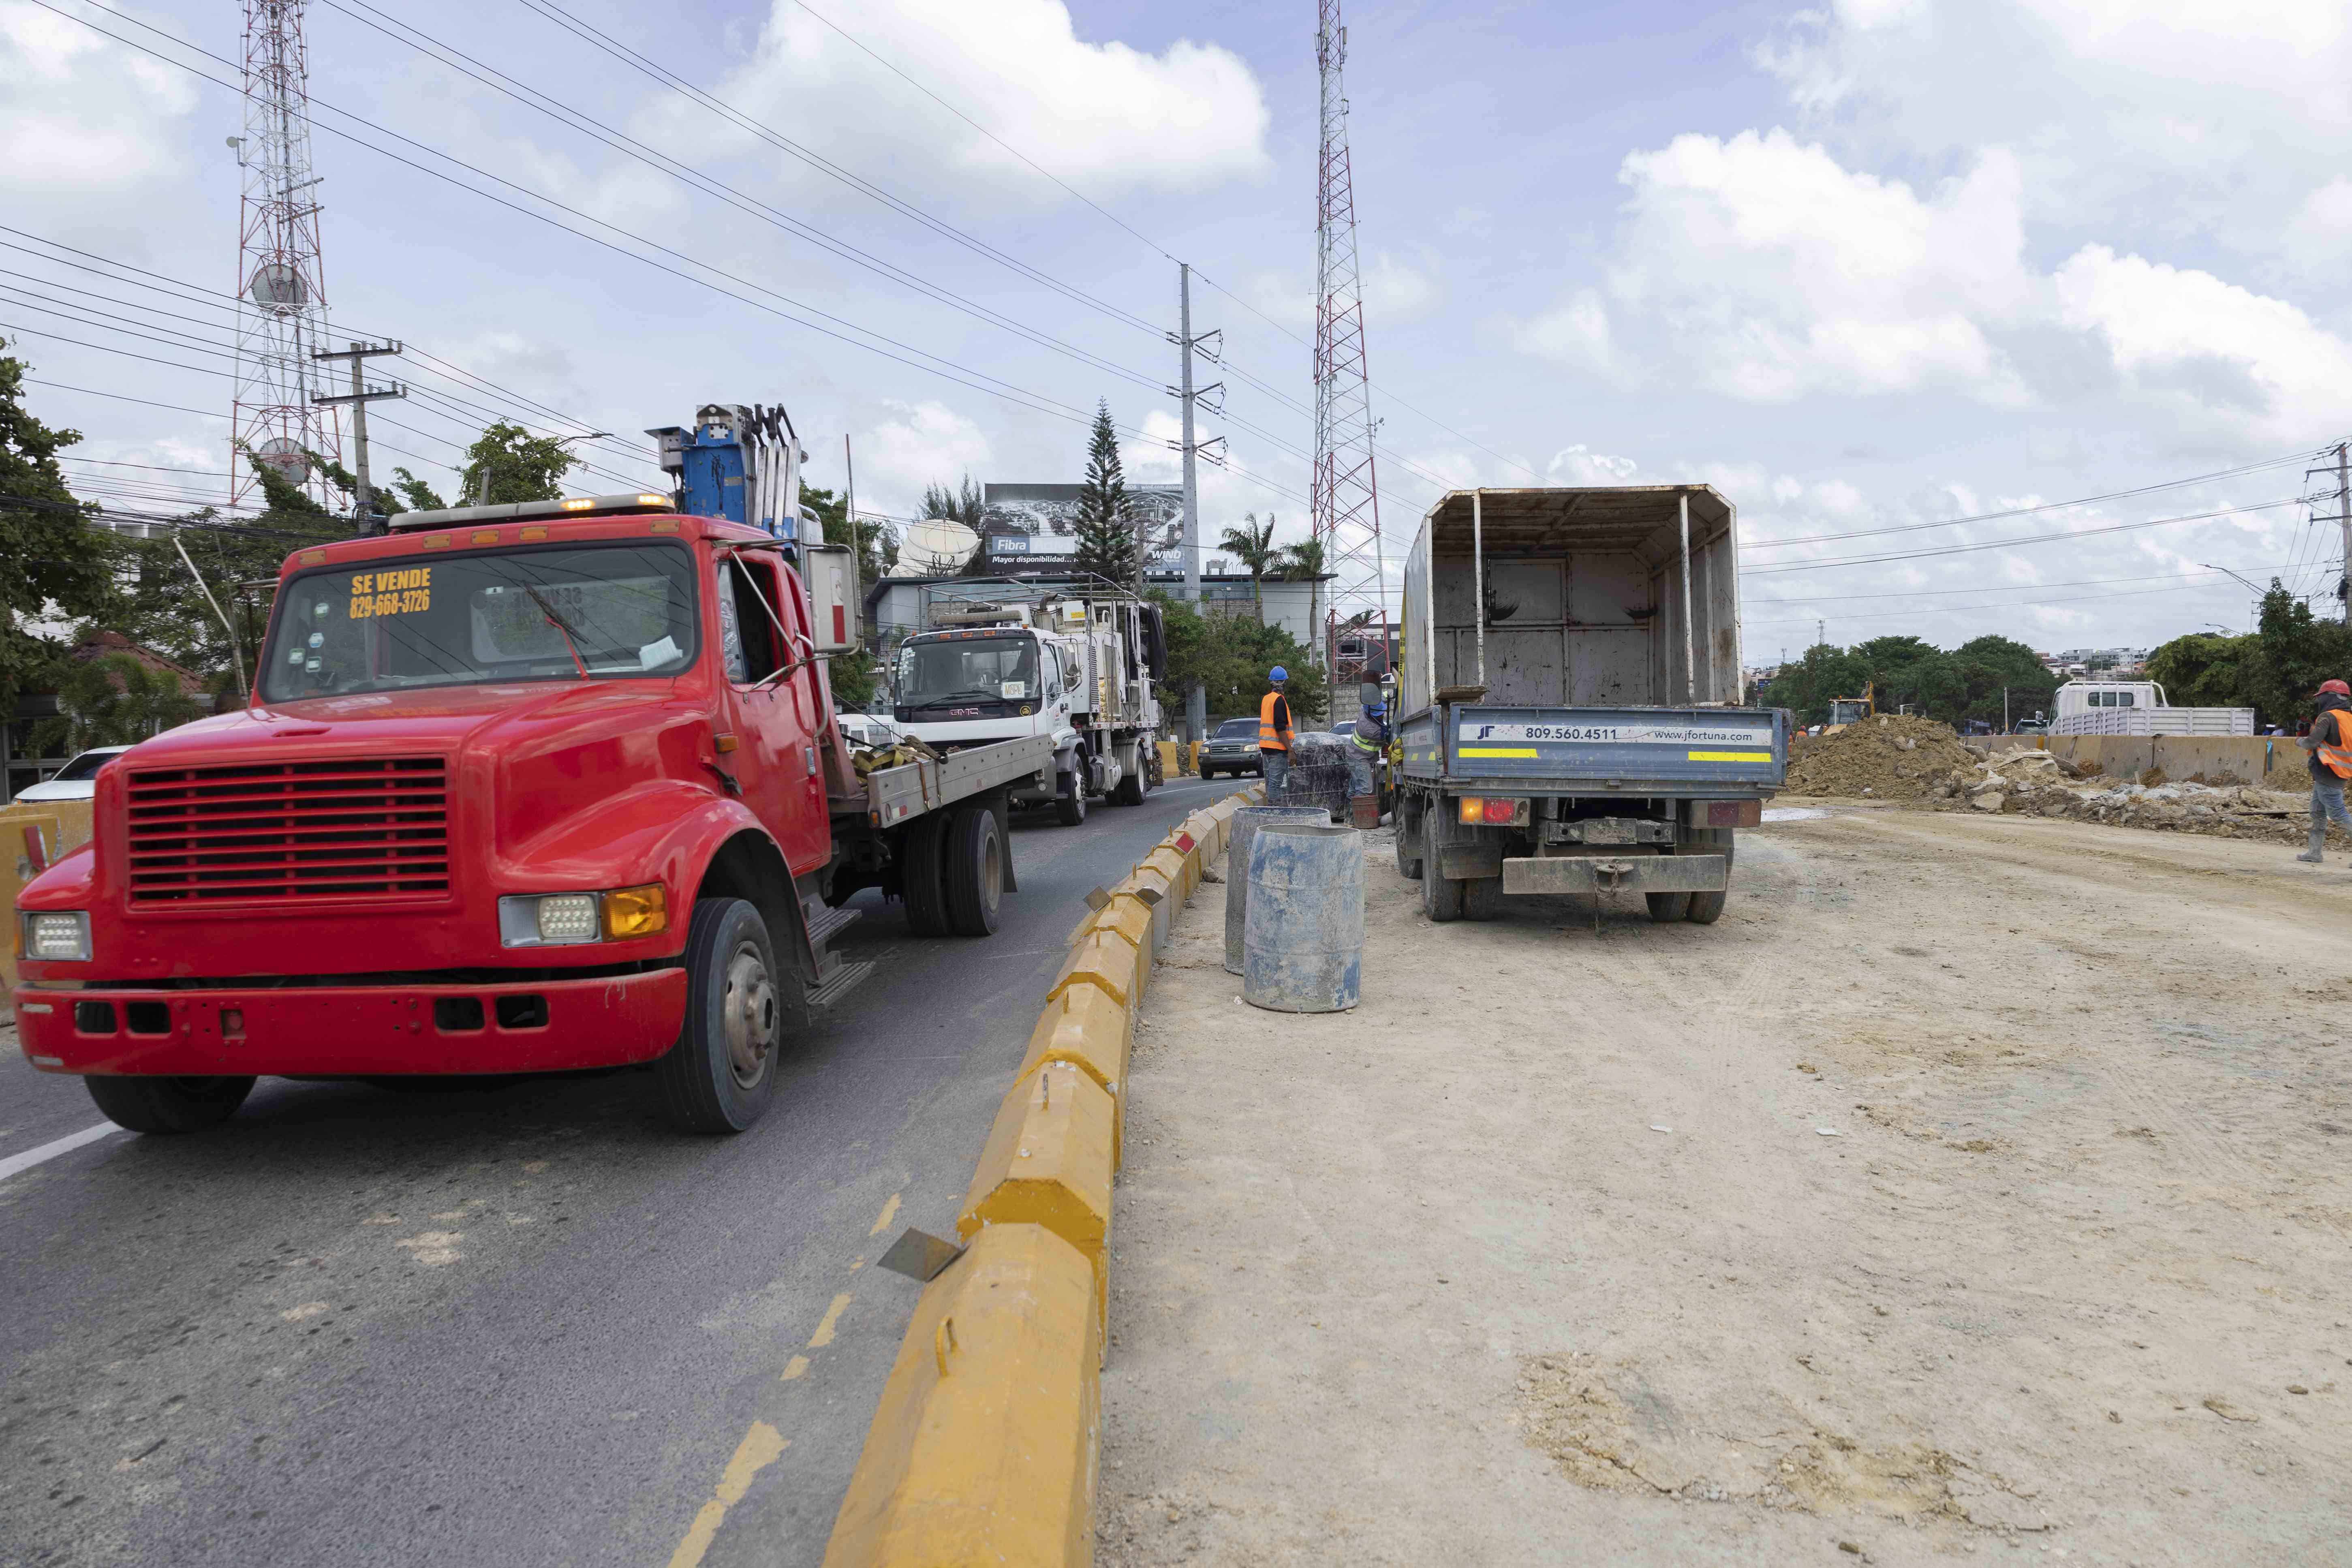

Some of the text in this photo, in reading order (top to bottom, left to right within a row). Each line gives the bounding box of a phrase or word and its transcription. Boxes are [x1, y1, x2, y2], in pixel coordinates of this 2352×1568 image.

[998, 539, 1026, 550] Fibra
[1151, 550, 1181, 559] WIND
[352, 568, 431, 595] SE VENDE
[350, 589, 430, 619] 829-668-3726
[949, 708, 978, 716] GMC
[1526, 727, 1617, 740] 809.560.4511
[1655, 730, 1752, 741] www.jfortuna.com
